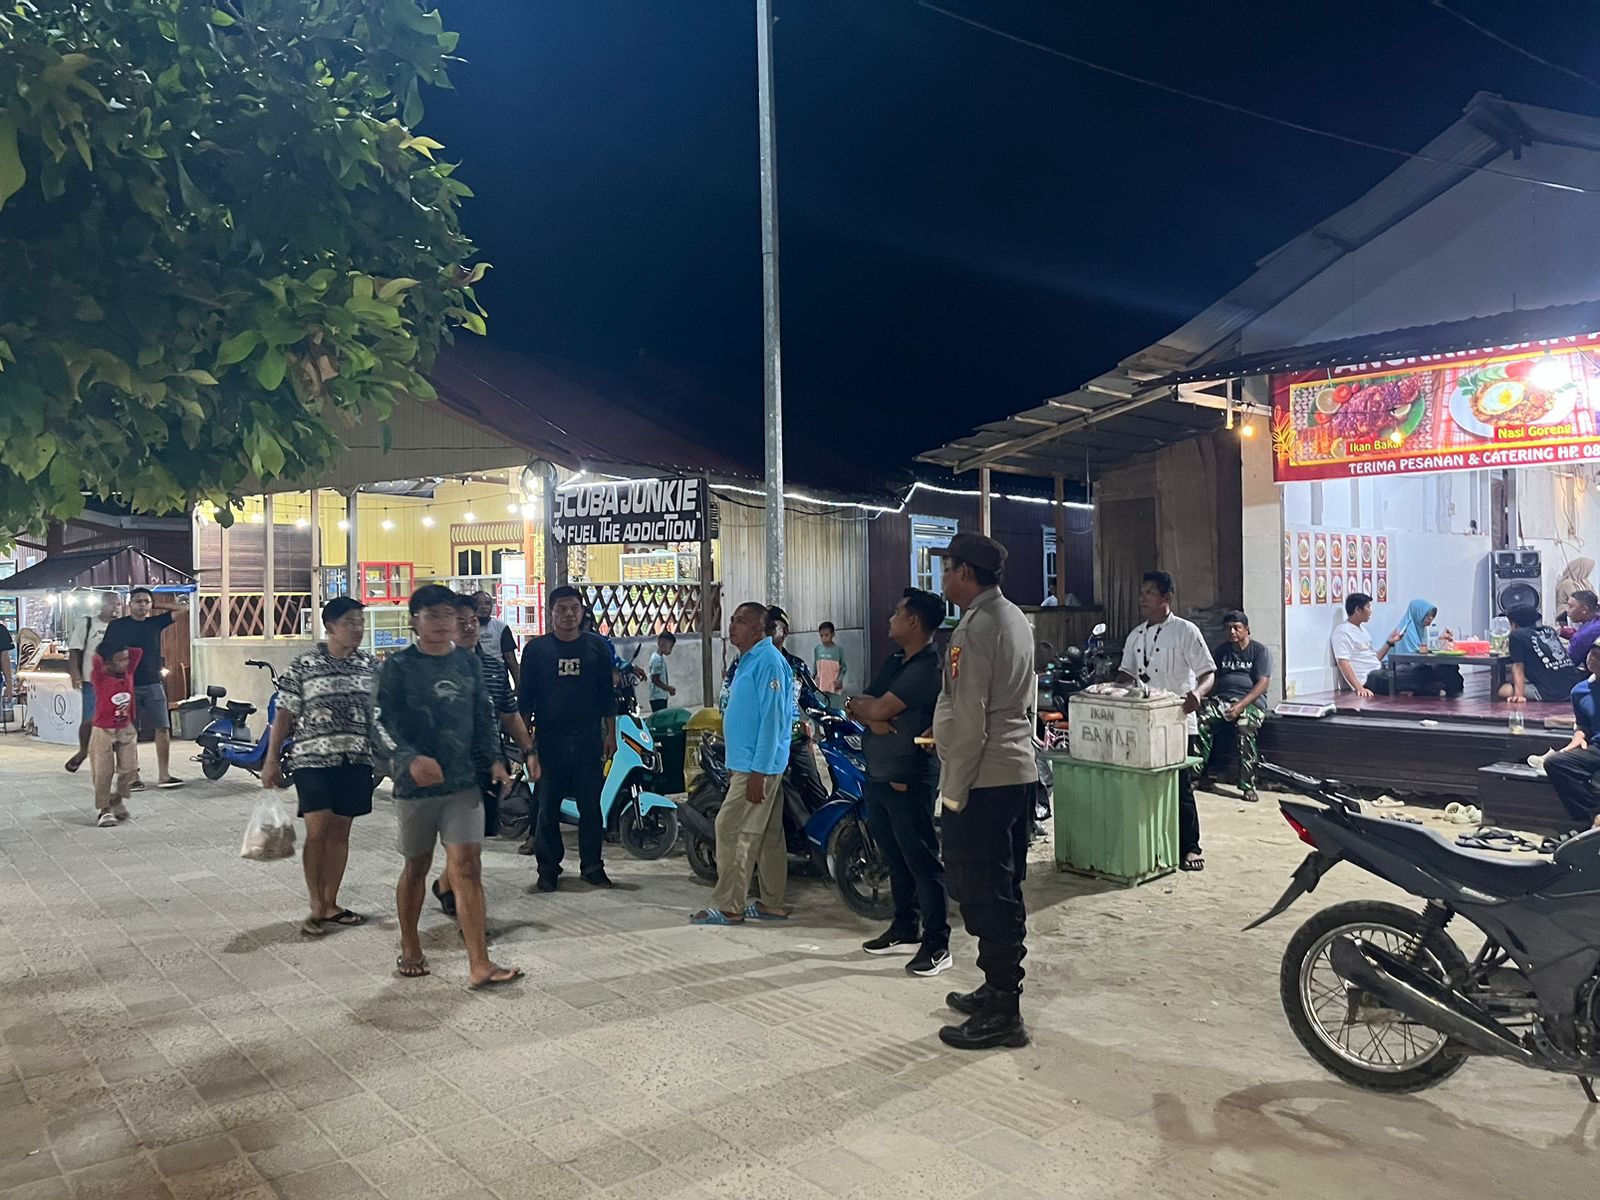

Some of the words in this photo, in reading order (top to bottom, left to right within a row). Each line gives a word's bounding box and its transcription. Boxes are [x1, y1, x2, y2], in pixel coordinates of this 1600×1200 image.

[1498, 426, 1524, 439] Nasi
[1529, 423, 1572, 437] Goreng
[1349, 442, 1371, 453] Ikan
[1349, 460, 1396, 475] TERIMA
[1400, 455, 1463, 470] PESANAN
[1468, 453, 1481, 466] &
[1482, 446, 1554, 466] CATERING
[553, 484, 618, 518] SCUBA
[620, 479, 698, 514] JUNKIE
[567, 524, 597, 543] FUEL
[598, 517, 621, 542] THE
[1090, 707, 1115, 720] IKAN
[1082, 726, 1137, 747] BAKAR
